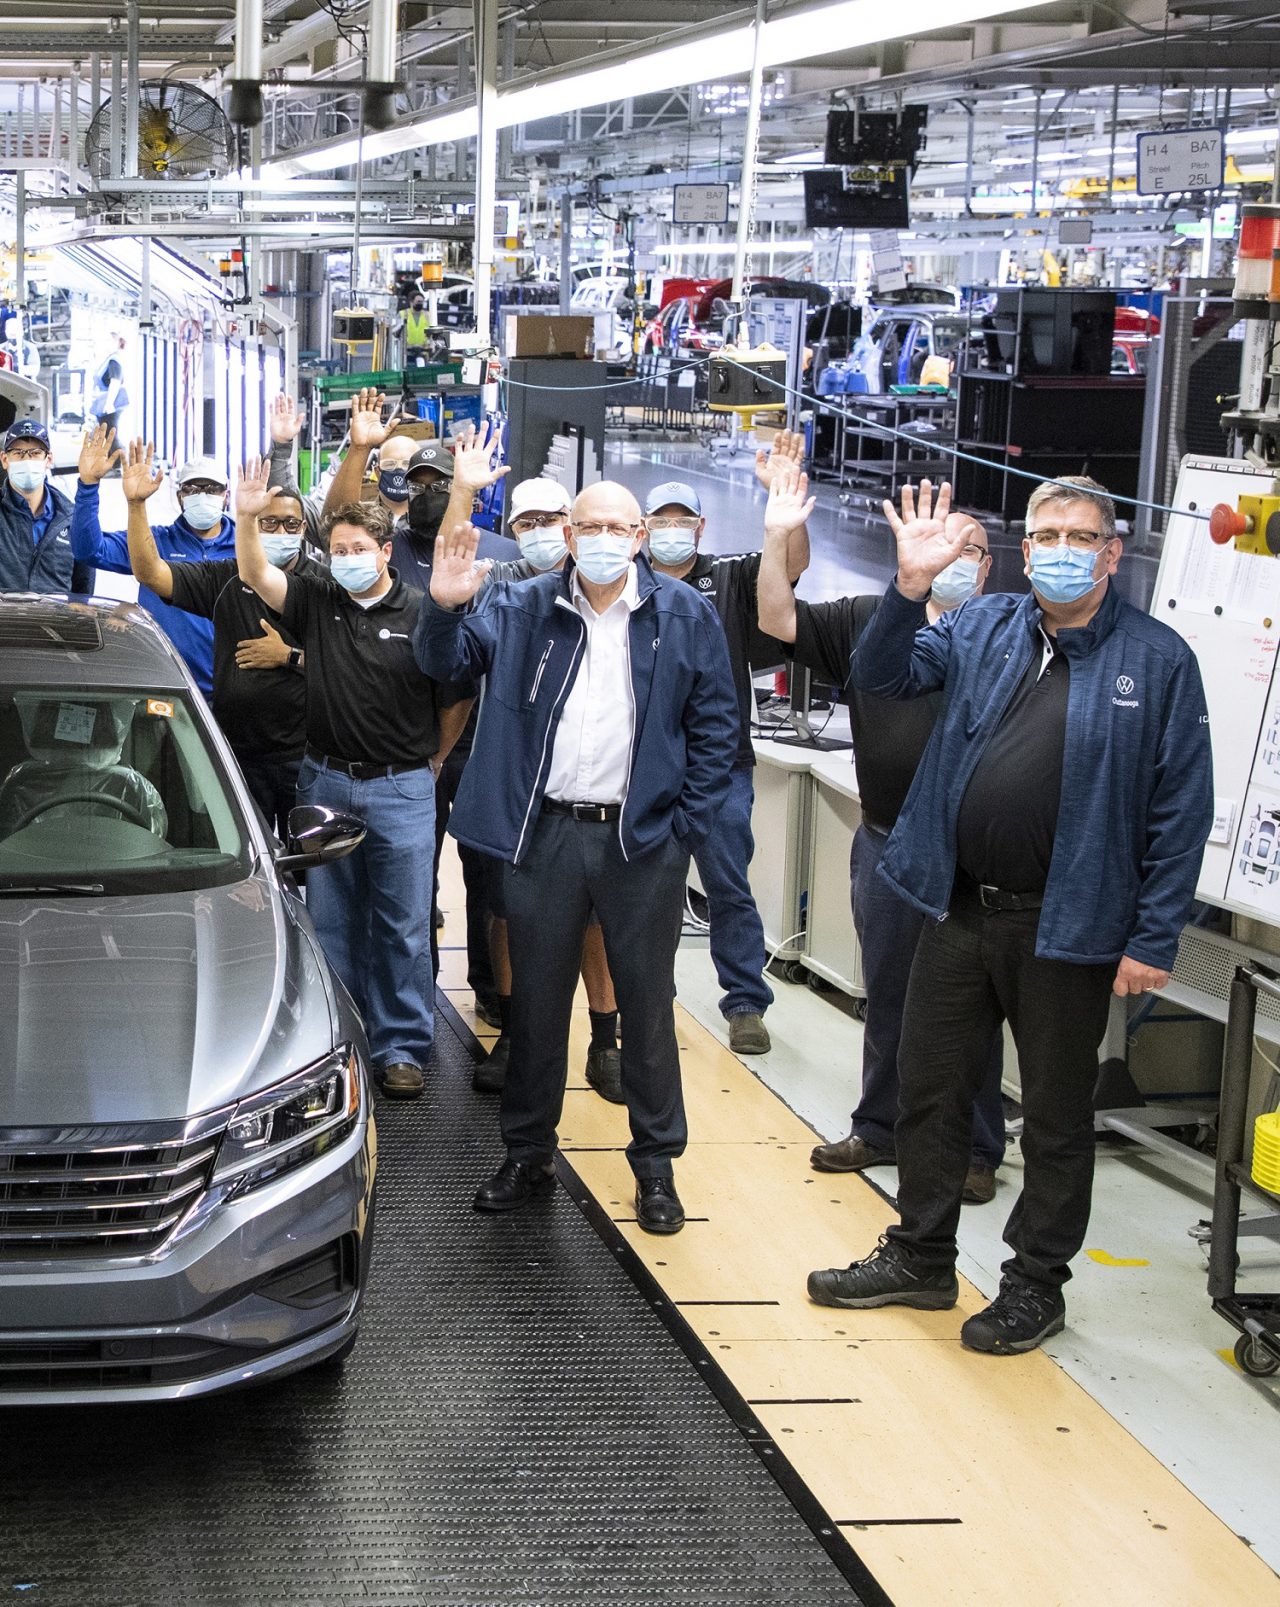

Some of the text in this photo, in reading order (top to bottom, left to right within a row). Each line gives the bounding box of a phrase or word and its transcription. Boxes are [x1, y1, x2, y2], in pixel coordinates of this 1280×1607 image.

[1146, 140, 1217, 156] H 4 BA7
[1148, 162, 1210, 174] Street Pitch
[1154, 174, 1212, 189] E 25L
[706, 191, 723, 199] BA7
[1116, 675, 1134, 695] VW
